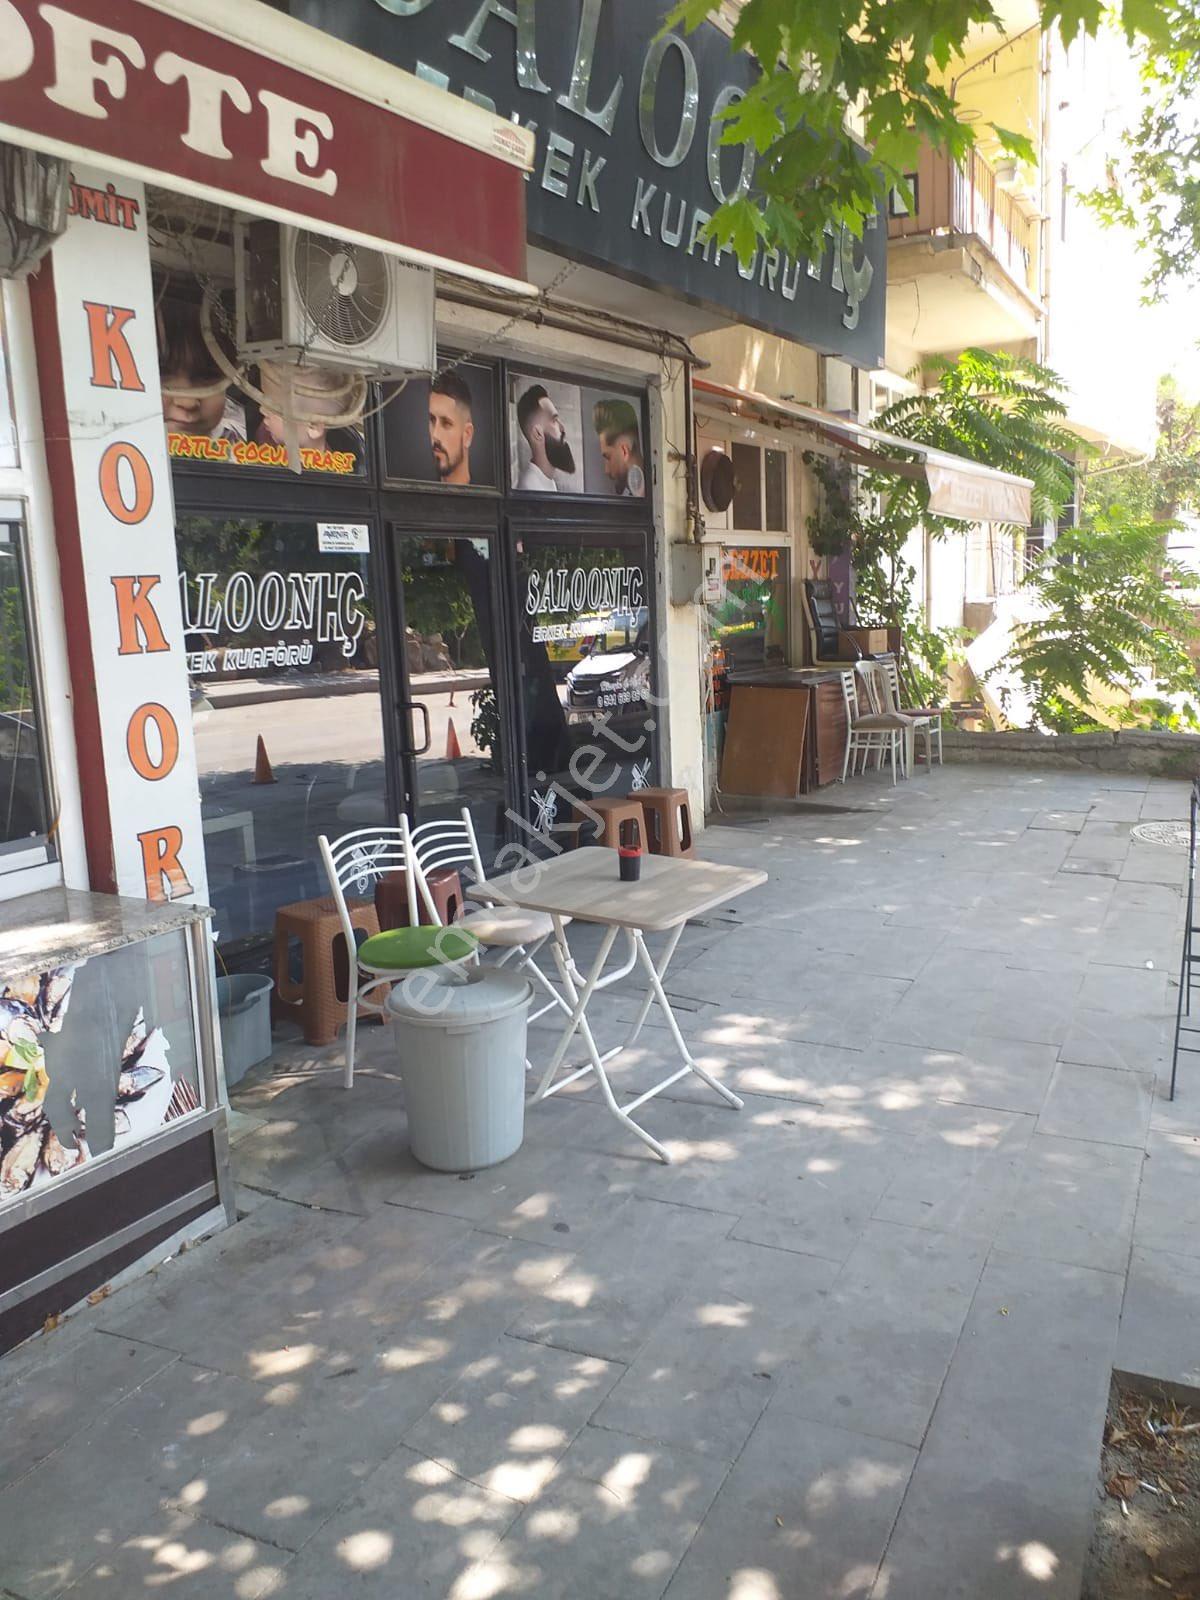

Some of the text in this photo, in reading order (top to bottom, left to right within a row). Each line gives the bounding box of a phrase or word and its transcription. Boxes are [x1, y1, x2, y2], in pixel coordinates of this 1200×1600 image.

[167, 432, 229, 462] TATLI
[525, 566, 644, 628] SALOONHÇ
[222, 639, 314, 671] KUAFÖRÜ
